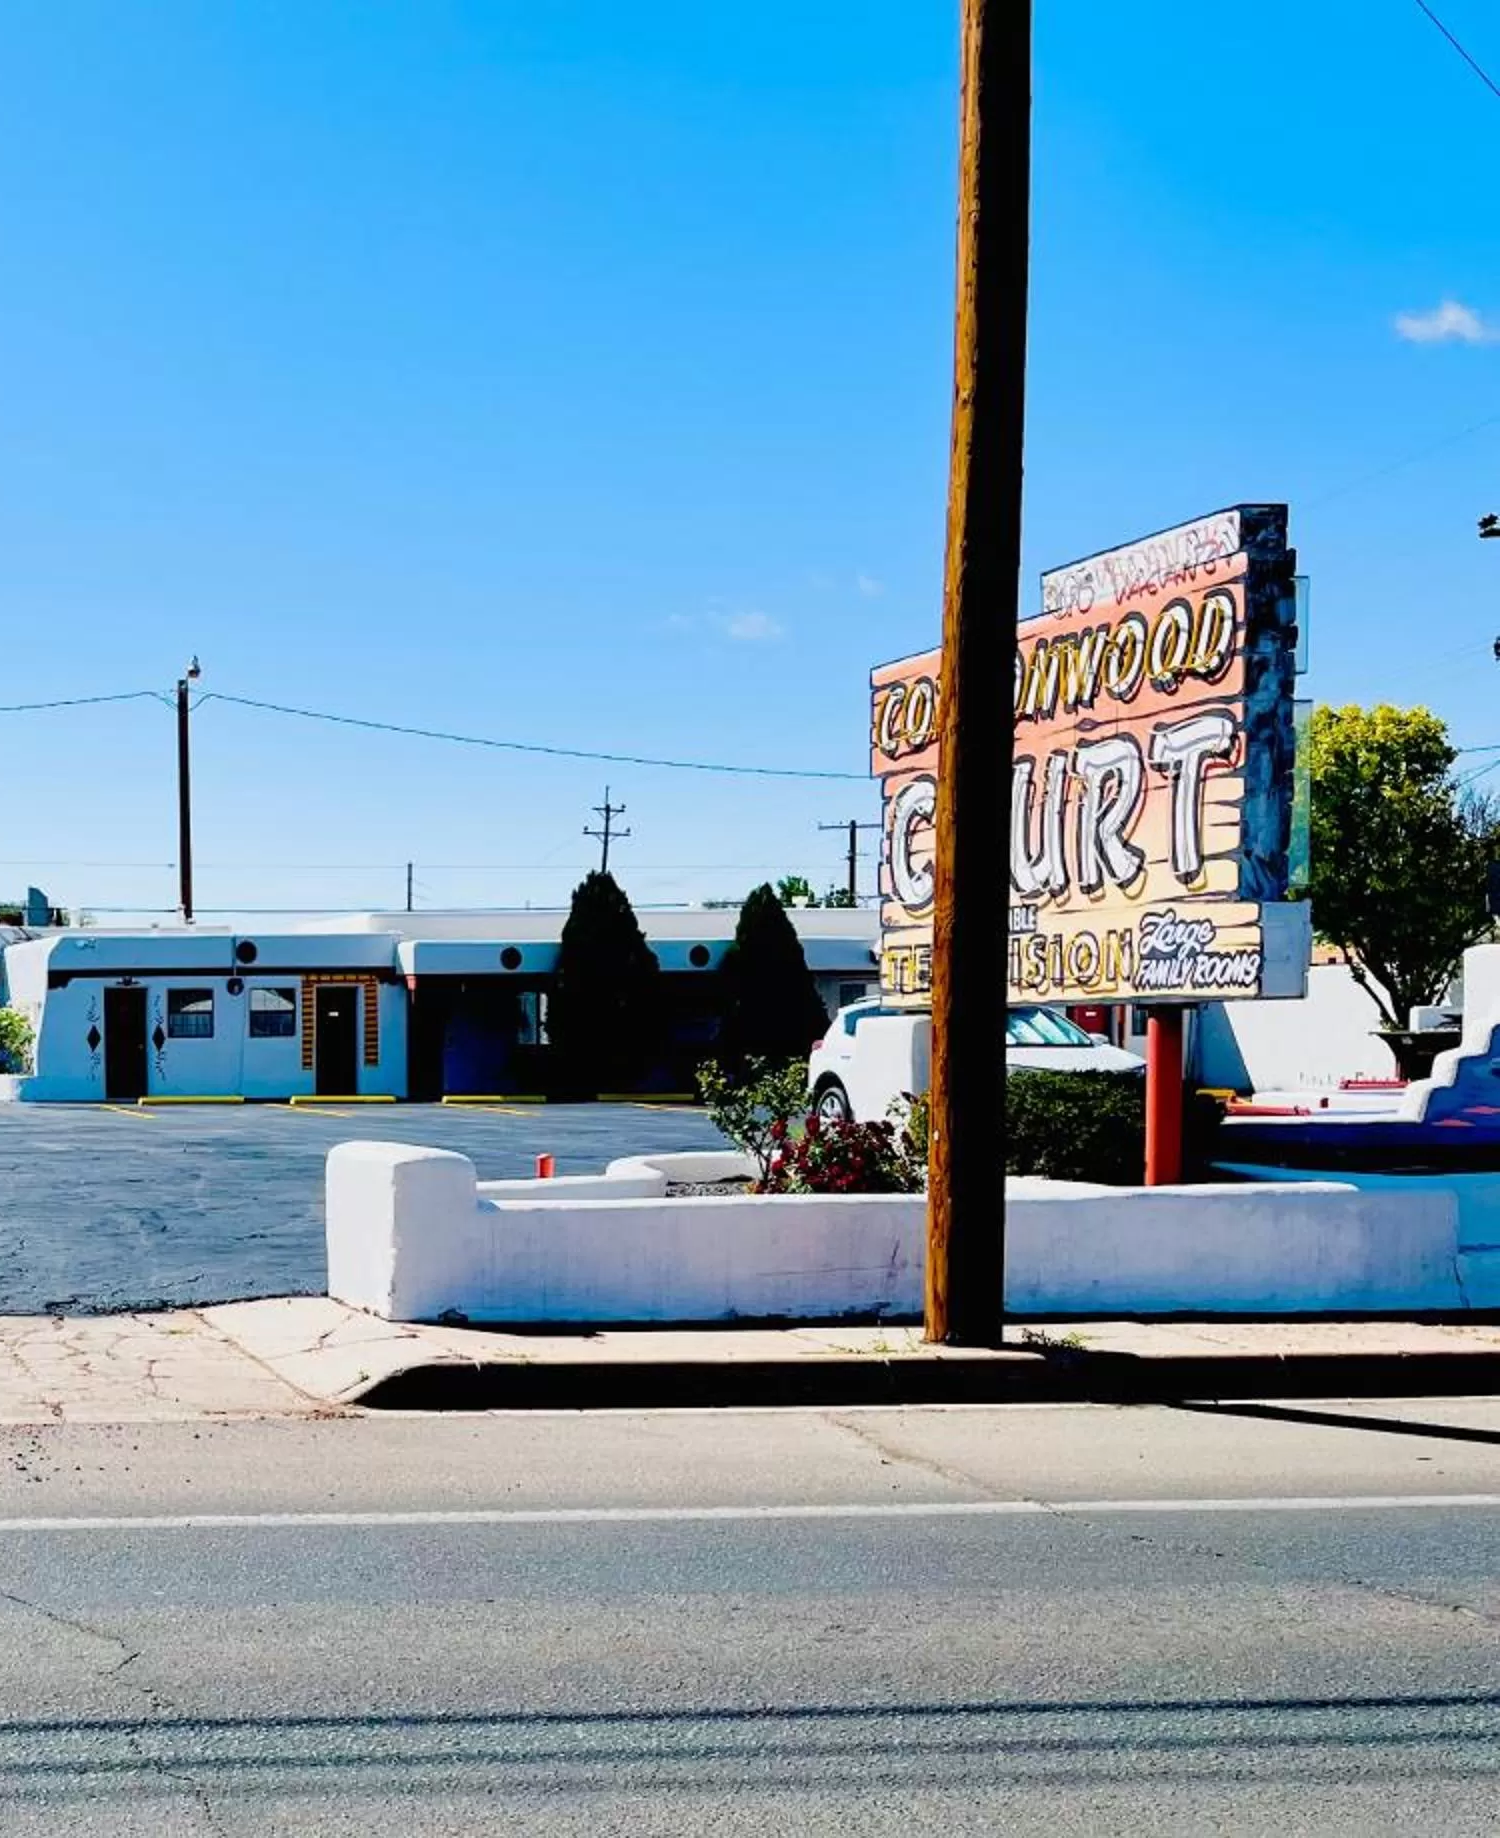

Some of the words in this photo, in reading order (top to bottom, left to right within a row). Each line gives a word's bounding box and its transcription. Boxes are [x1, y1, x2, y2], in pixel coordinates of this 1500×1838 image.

[876, 587, 1238, 762] CONWOOD
[889, 708, 1238, 912] CURT
[887, 928, 1134, 993] TEISION
[1139, 908, 1215, 960] Large
[1136, 954, 1196, 990] FAMILY
[1192, 949, 1261, 987] ROOMS
